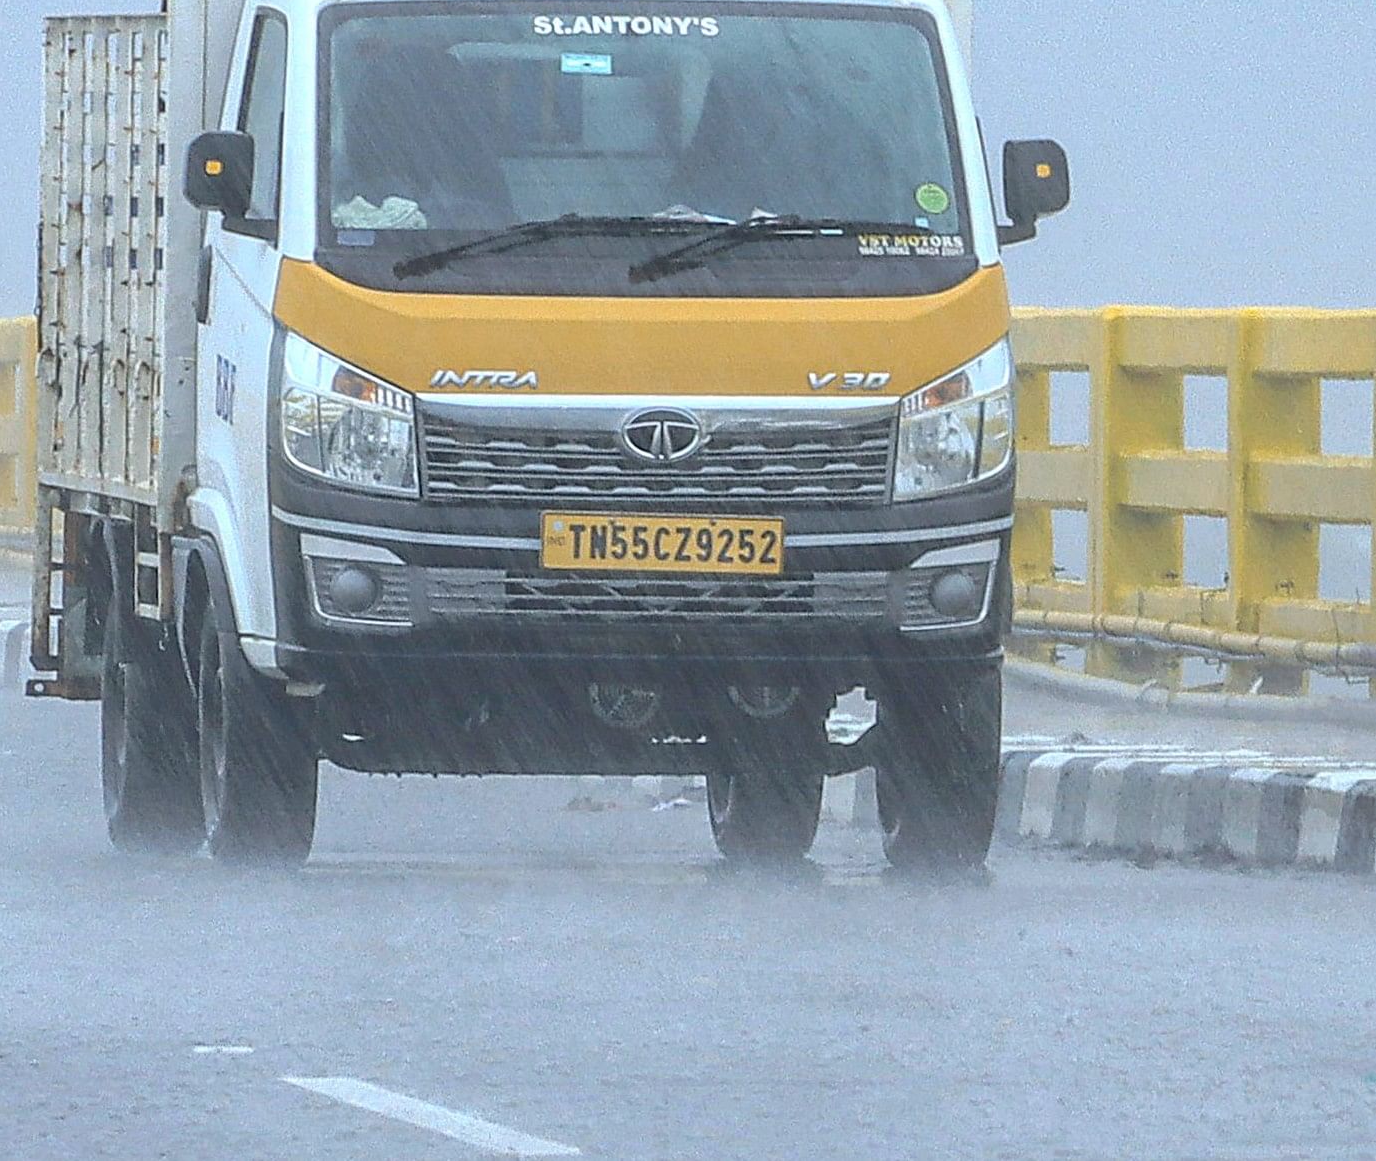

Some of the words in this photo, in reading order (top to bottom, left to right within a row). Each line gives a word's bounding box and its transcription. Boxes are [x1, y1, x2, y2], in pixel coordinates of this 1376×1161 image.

[534, 15, 719, 37] St.ANTONY'S
[895, 235, 964, 247] MOTORS
[431, 370, 538, 390] INTRA
[808, 372, 837, 390] V
[840, 372, 890, 391] 30
[569, 524, 777, 564] TN55CZ9252
